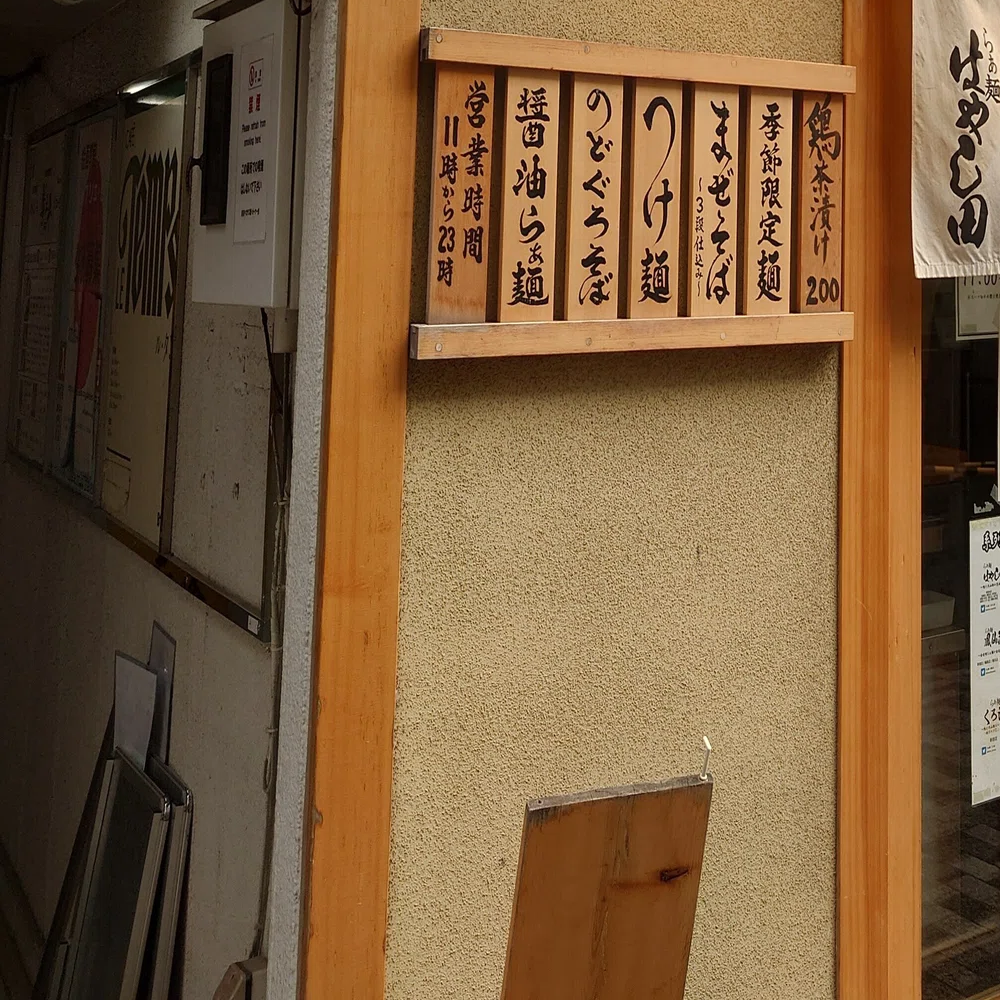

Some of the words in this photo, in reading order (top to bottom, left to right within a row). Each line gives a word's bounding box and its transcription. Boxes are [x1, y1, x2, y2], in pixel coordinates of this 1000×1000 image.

[460, 80, 490, 264] 営業時間
[578, 88, 614, 306] のどぐろそば
[638, 96, 677, 303] つけ麺
[755, 103, 785, 302] 季節限定麺
[806, 276, 840, 306] 200
